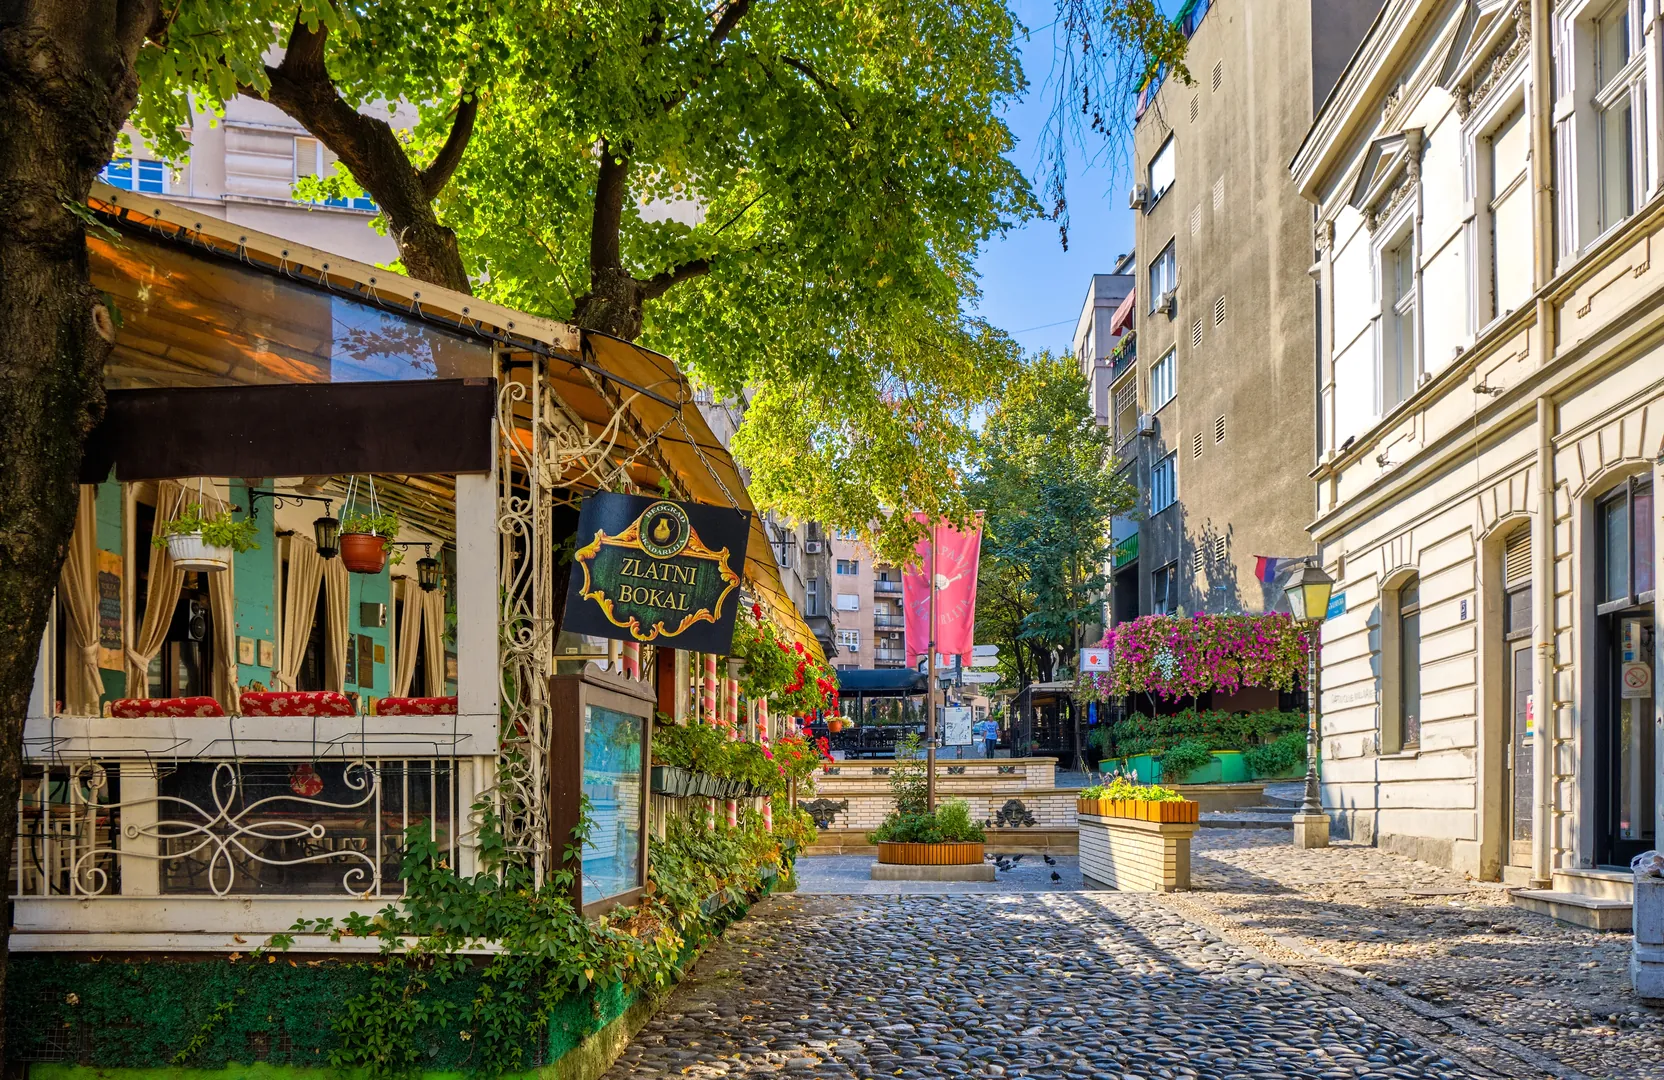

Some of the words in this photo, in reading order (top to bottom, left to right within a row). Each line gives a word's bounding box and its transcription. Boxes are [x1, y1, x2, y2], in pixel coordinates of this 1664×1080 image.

[645, 505, 686, 523] BEOGRAD
[640, 532, 685, 556] SKADARLIJA
[621, 559, 697, 585] ZLATNI
[619, 585, 689, 611] BOKAL
